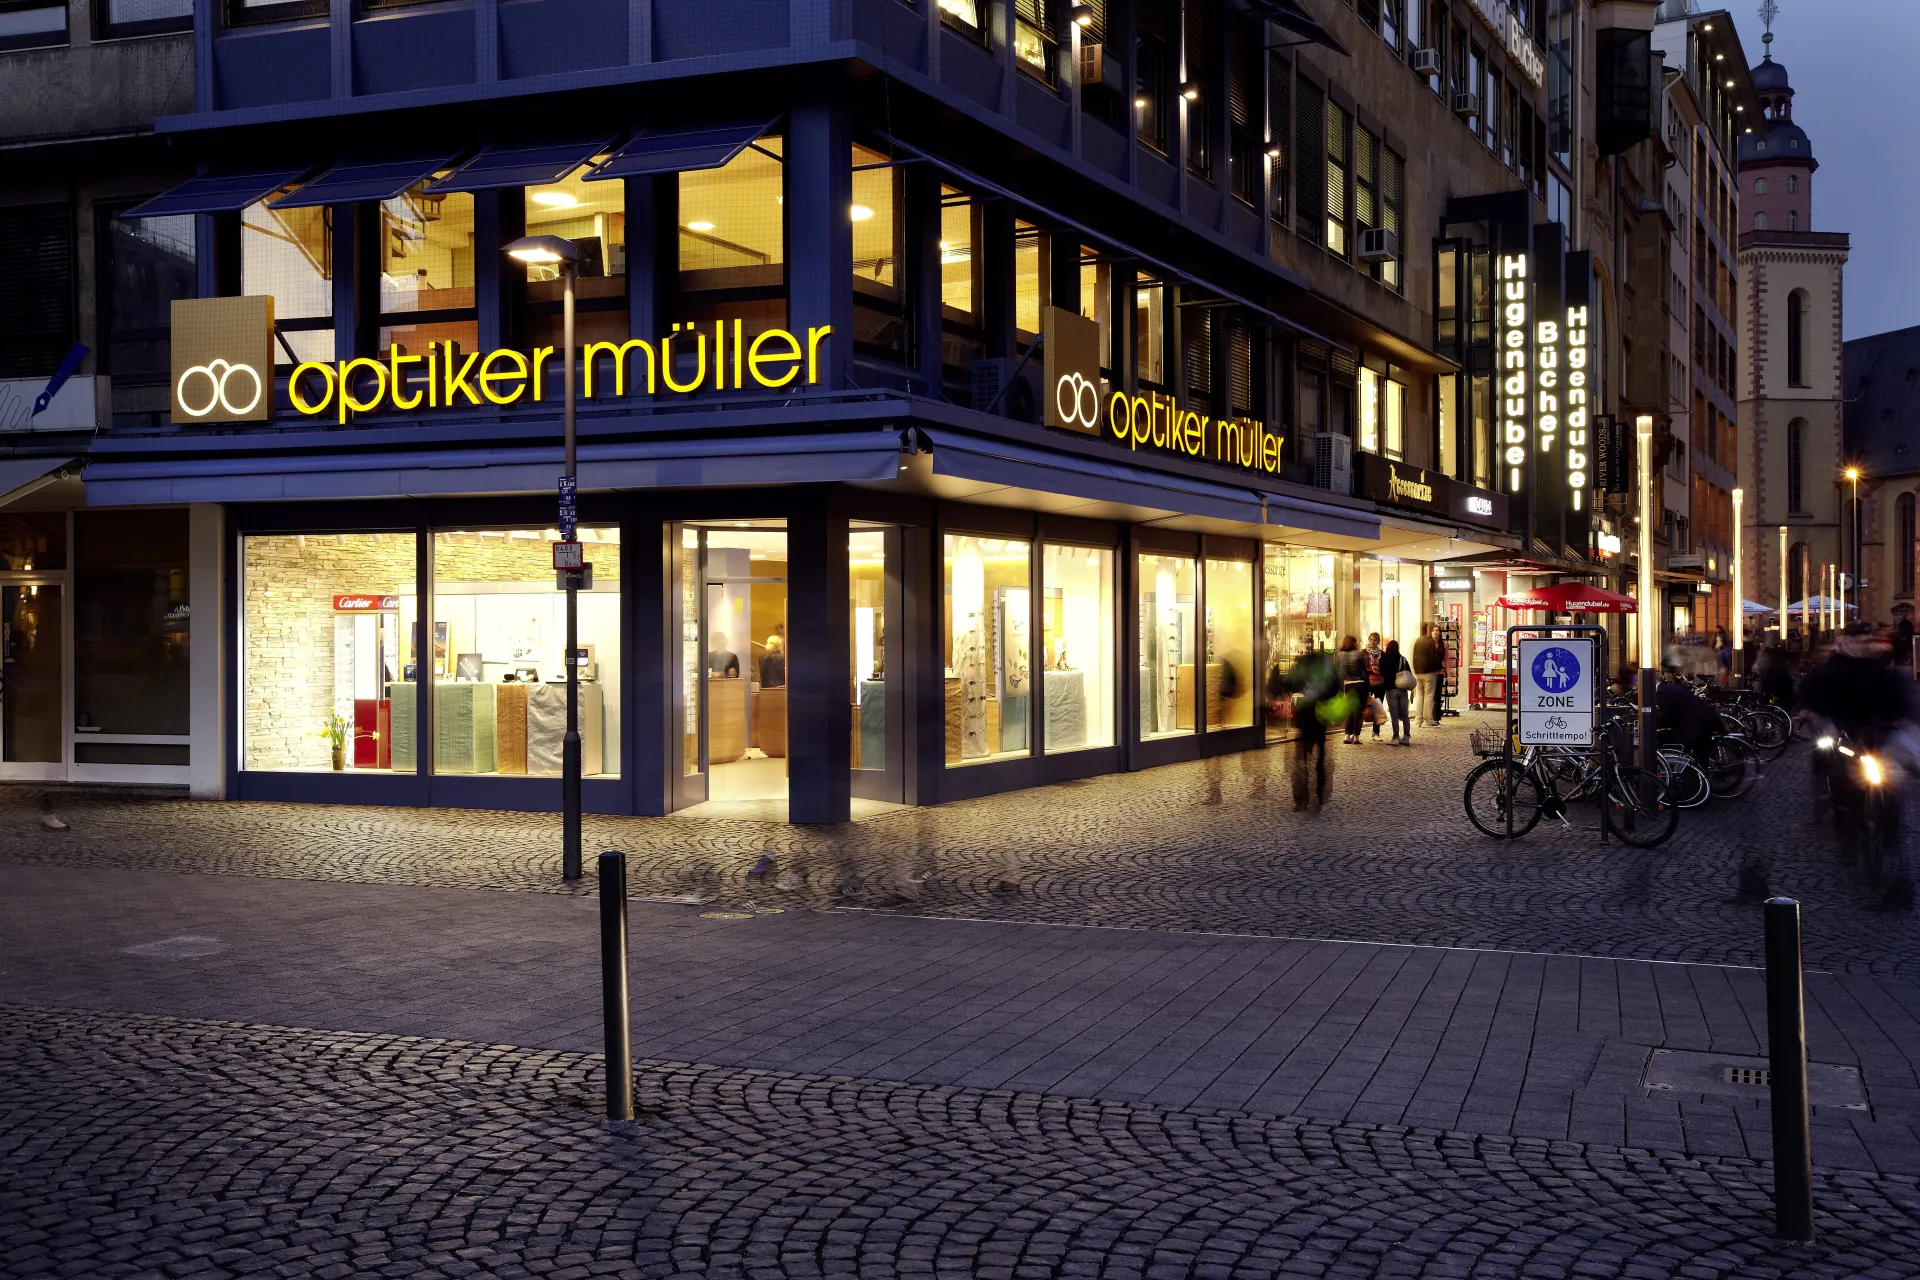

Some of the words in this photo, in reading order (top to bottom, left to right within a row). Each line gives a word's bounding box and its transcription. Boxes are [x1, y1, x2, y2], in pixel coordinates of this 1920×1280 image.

[1508, 13, 1544, 88] Bücher
[288, 340, 554, 425] optiker
[584, 318, 832, 398] müller
[1504, 254, 1526, 492] Hugendubel
[1538, 321, 1558, 452] Bücher
[1109, 390, 1211, 457] optiker
[1217, 417, 1285, 474] müller
[1567, 306, 1587, 511] Hugendubel
[1598, 428, 1607, 459] WOODS
[1599, 460, 1607, 487] RIVER
[338, 596, 373, 609] Cartier
[1565, 600, 1610, 608] Hugendubel.de
[1537, 696, 1575, 708] ZONE
[1525, 731, 1587, 741] Schritttempo!
